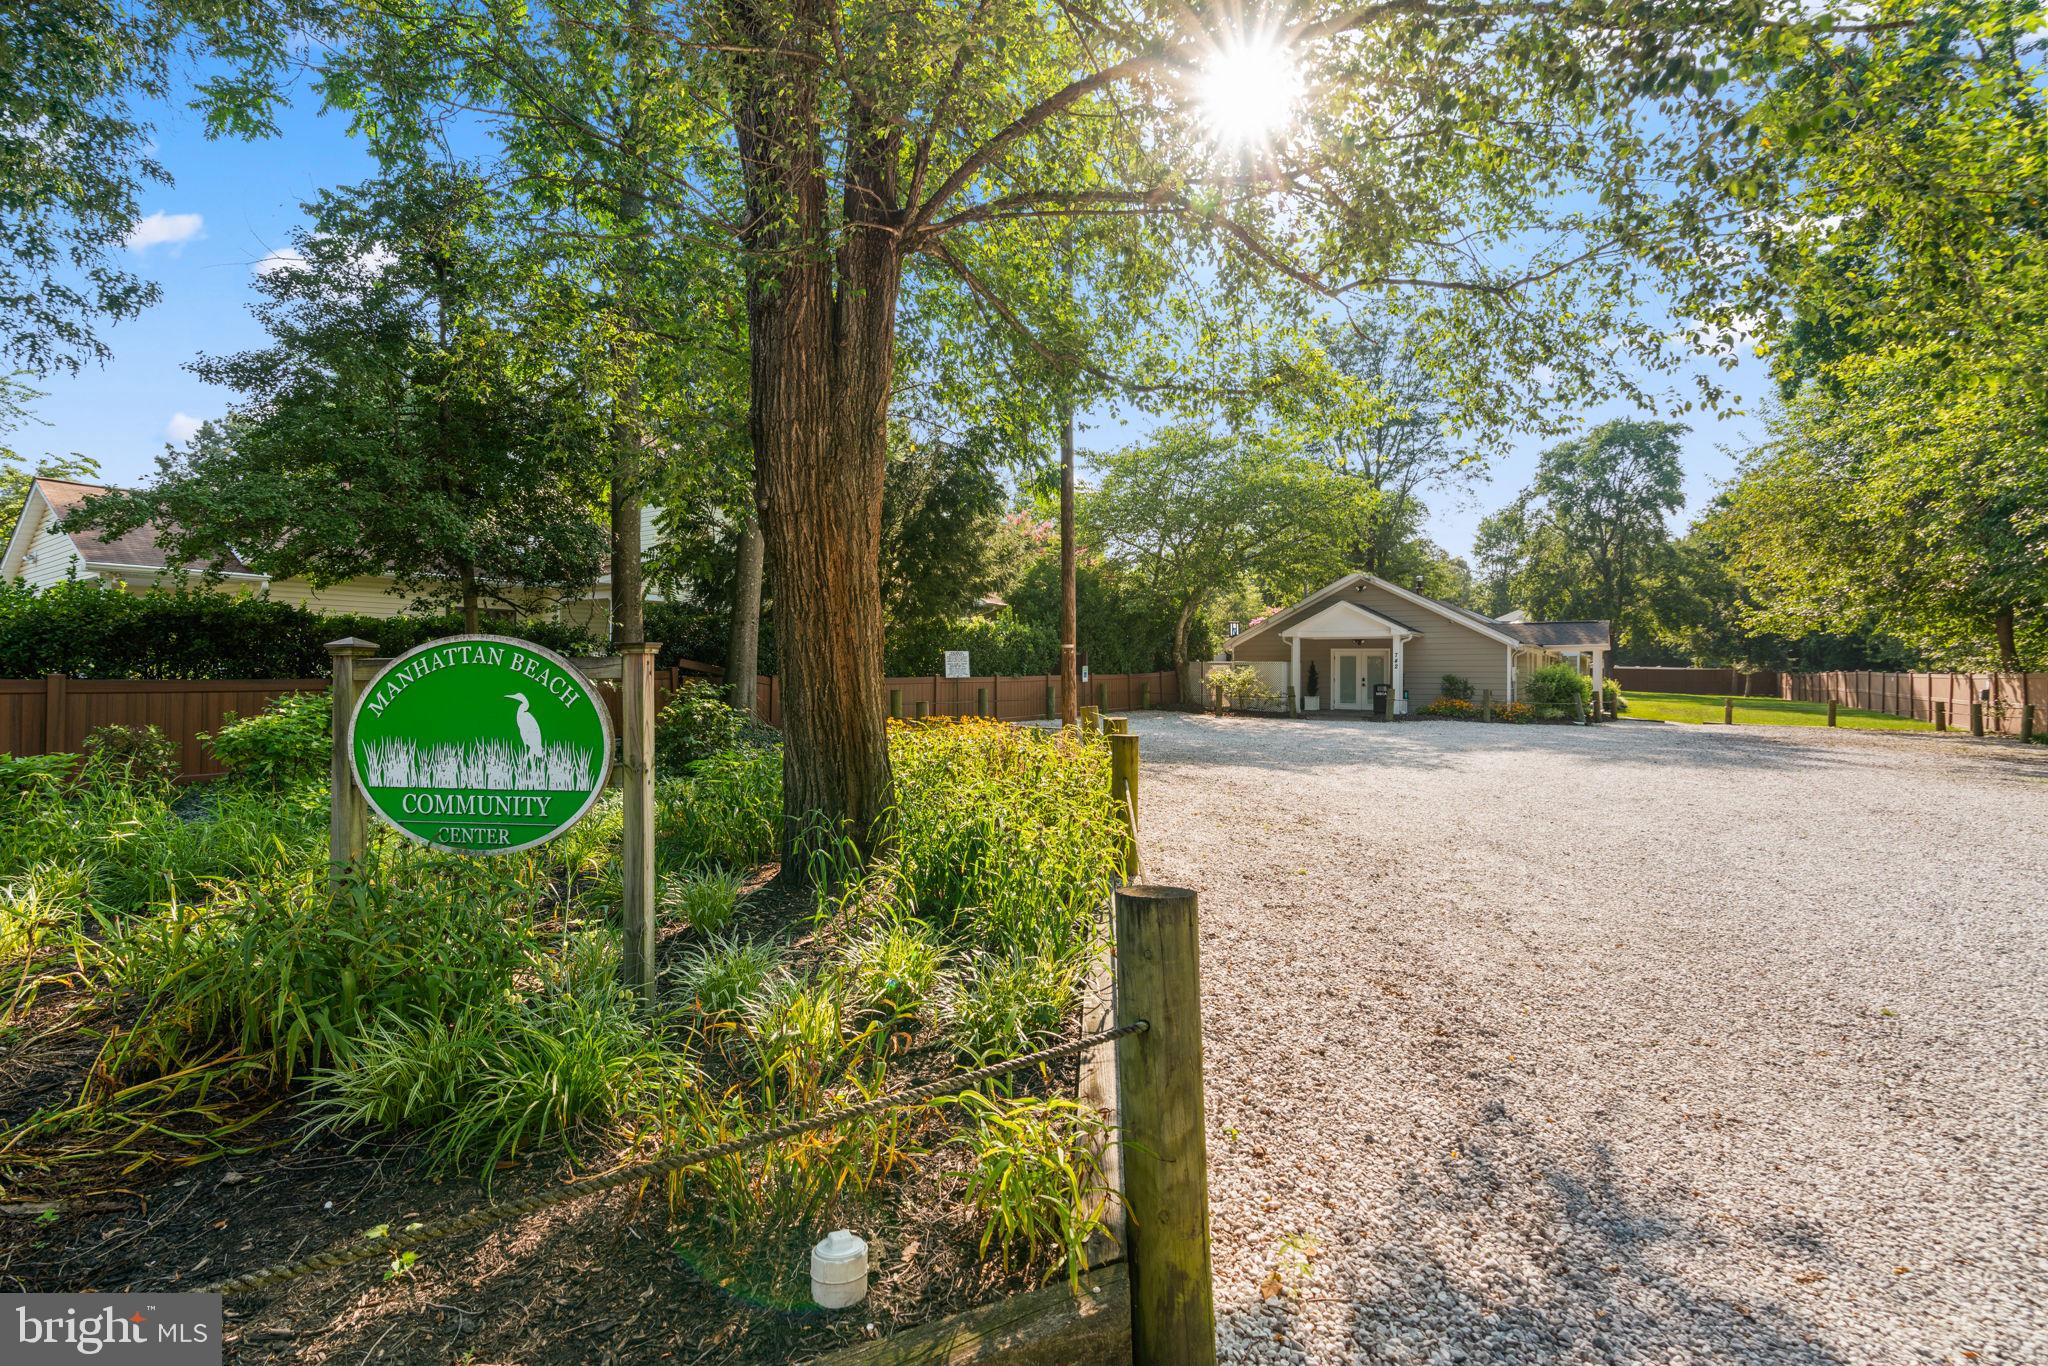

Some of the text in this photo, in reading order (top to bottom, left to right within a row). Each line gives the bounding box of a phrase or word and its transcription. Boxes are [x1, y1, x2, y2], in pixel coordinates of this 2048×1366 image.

[367, 645, 581, 719] MANHATTAN BEACH
[402, 793, 552, 817] COMMUNITY
[438, 826, 512, 845] CENTER
